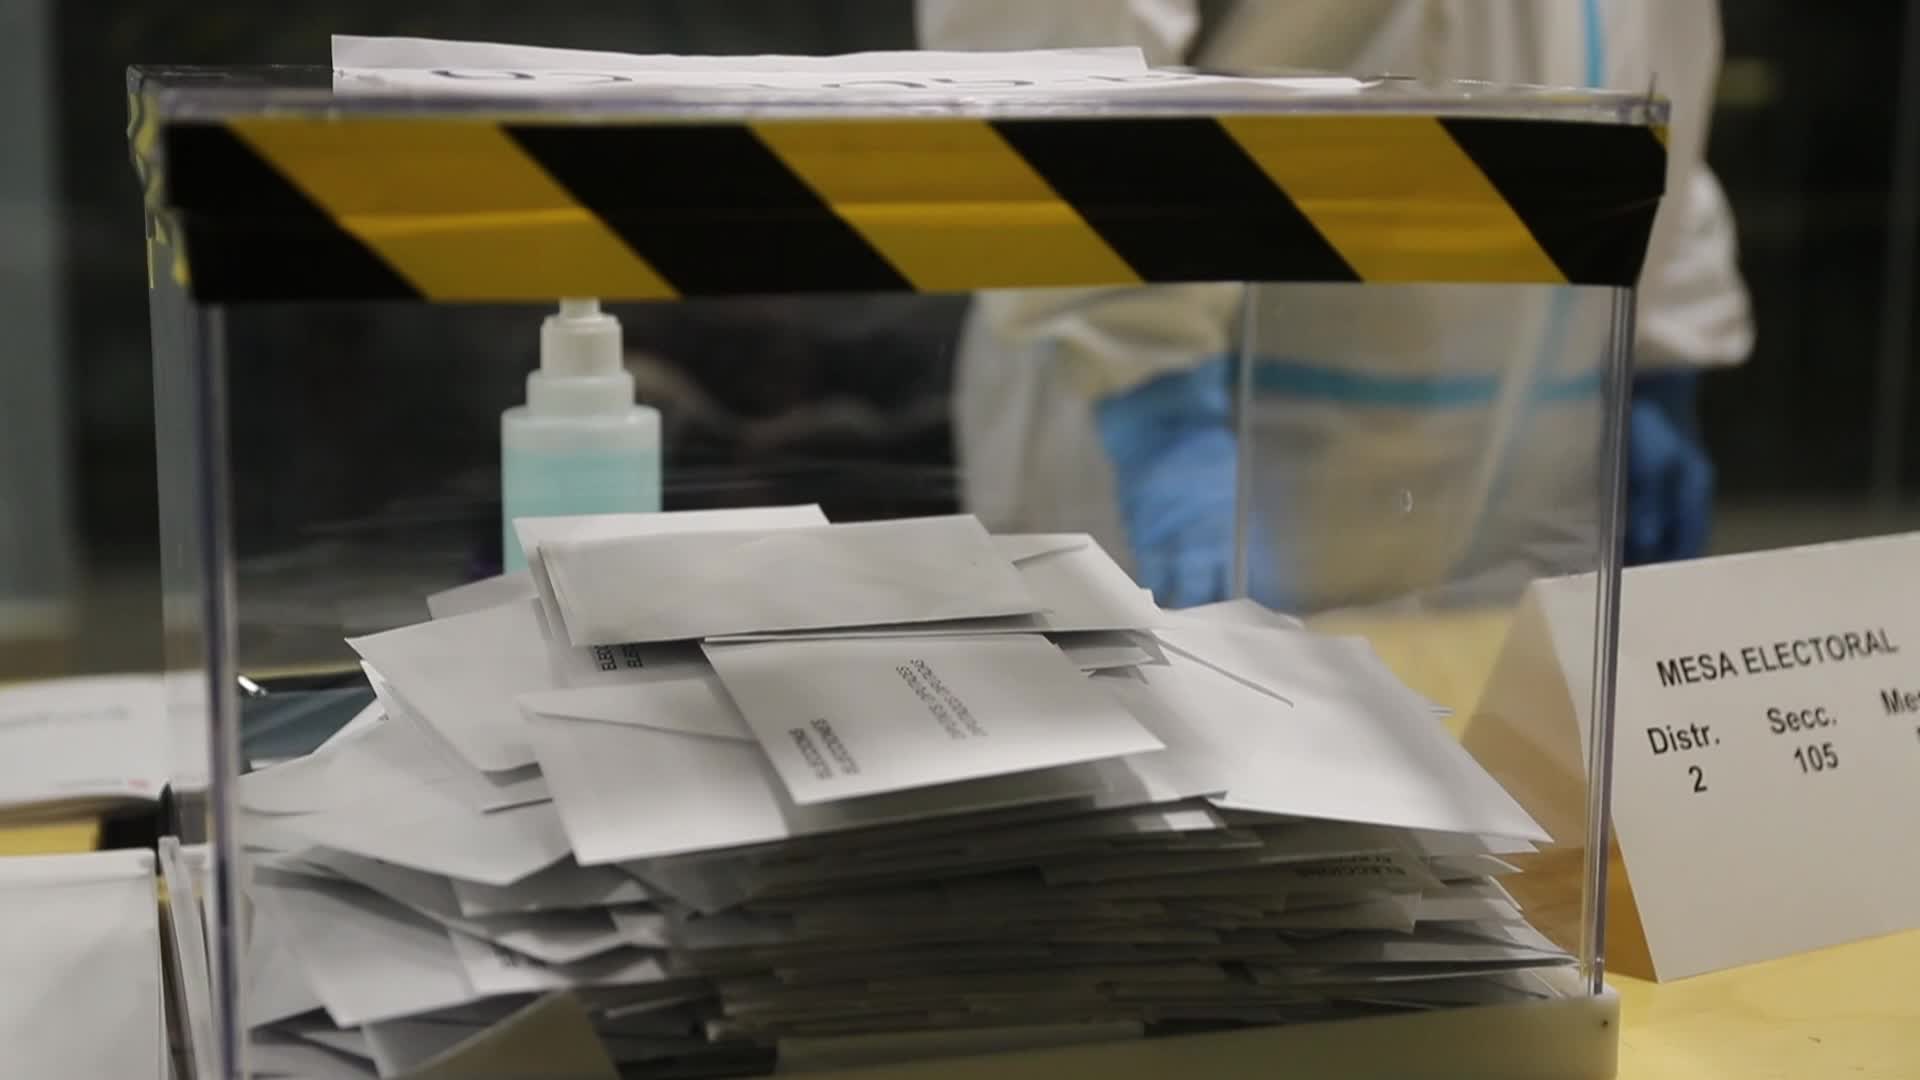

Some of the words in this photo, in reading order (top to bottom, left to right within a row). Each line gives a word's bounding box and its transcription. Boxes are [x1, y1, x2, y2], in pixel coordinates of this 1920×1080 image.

[1656, 651, 1738, 687] MESA
[1741, 627, 1898, 675] ELECTORAL
[1647, 722, 1721, 755] Distr.
[1767, 706, 1838, 735] Secc.
[1688, 764, 1708, 793] 2
[1794, 742, 1840, 774] 105
